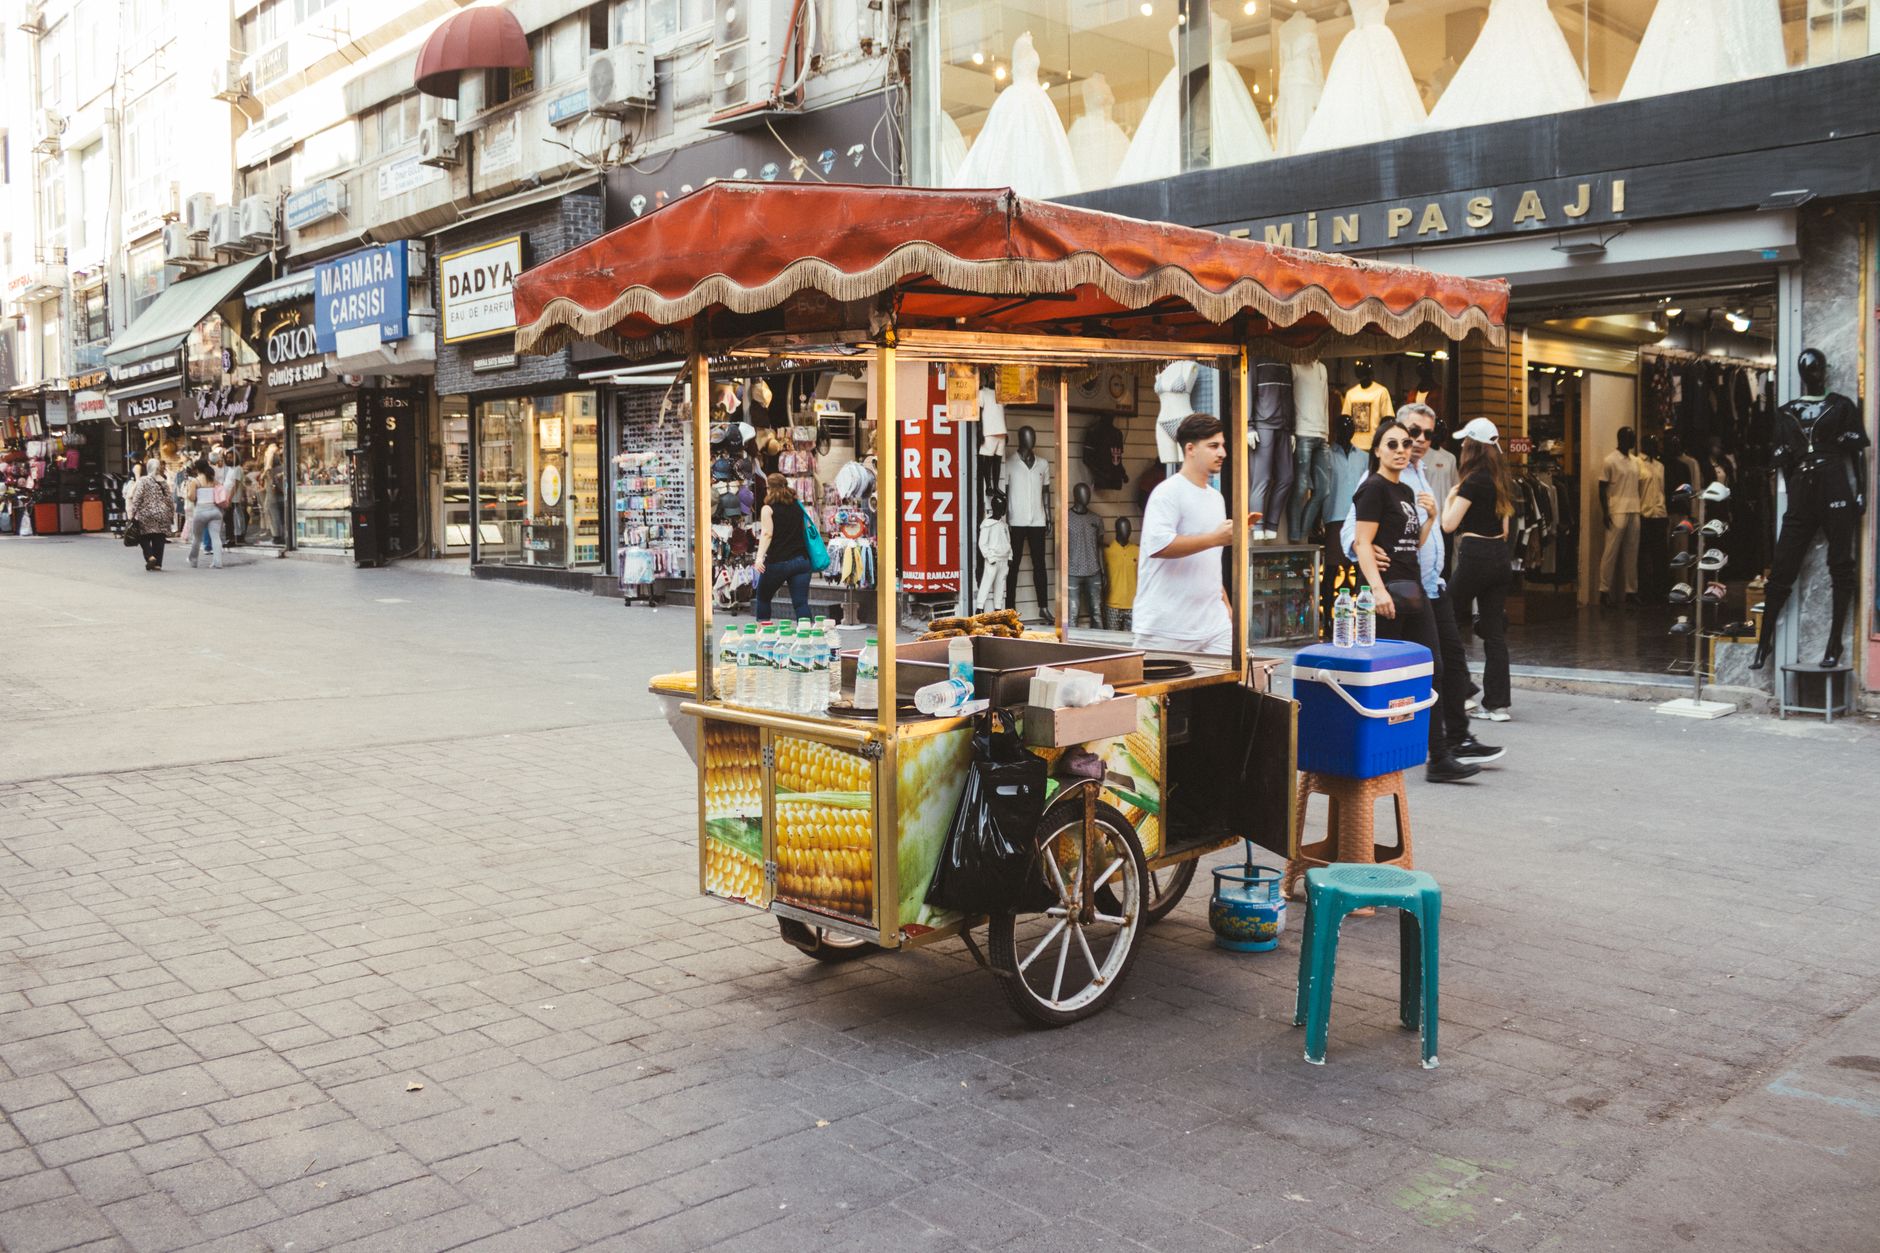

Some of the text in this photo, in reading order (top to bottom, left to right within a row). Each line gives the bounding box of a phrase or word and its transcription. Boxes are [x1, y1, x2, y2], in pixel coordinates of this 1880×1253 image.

[1388, 180, 1625, 238] PASAJI
[321, 250, 394, 296] MARMARA
[449, 261, 514, 299] DADYA
[330, 287, 384, 330] ÇARŞISI
[450, 310, 465, 322] EAU
[469, 306, 479, 319] DE
[384, 324, 398, 337] No:11
[268, 362, 324, 386] GÜMÜŞ & SAAT
[903, 419, 921, 565] ERZİ
[902, 571, 925, 580] RAMAZAN
[926, 570, 960, 580] RAMAZAN
